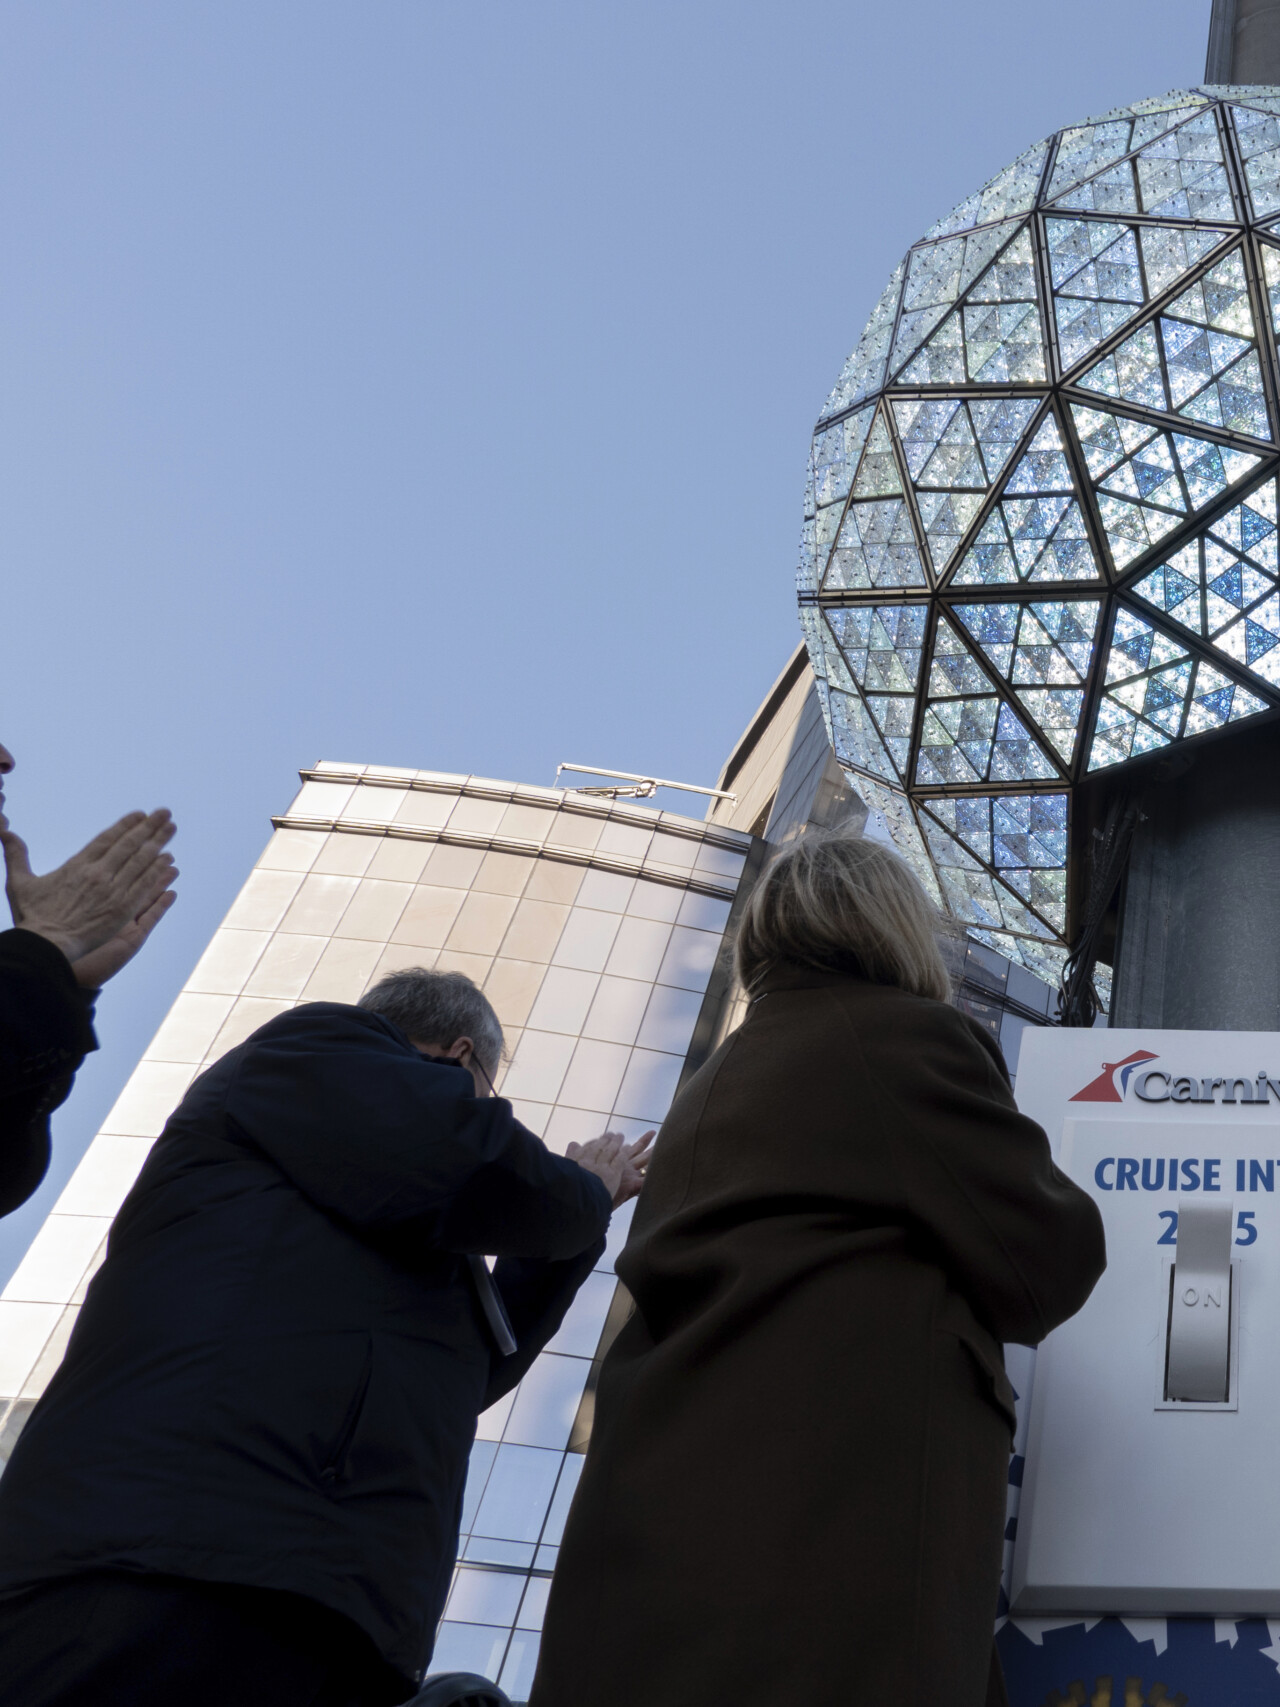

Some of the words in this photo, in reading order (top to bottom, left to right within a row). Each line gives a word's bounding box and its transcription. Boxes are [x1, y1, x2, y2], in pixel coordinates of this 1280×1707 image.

[1094, 1157, 1221, 1191] CRUISE
[1156, 1210, 1258, 1246] 25
[1181, 1287, 1222, 1308] ON
